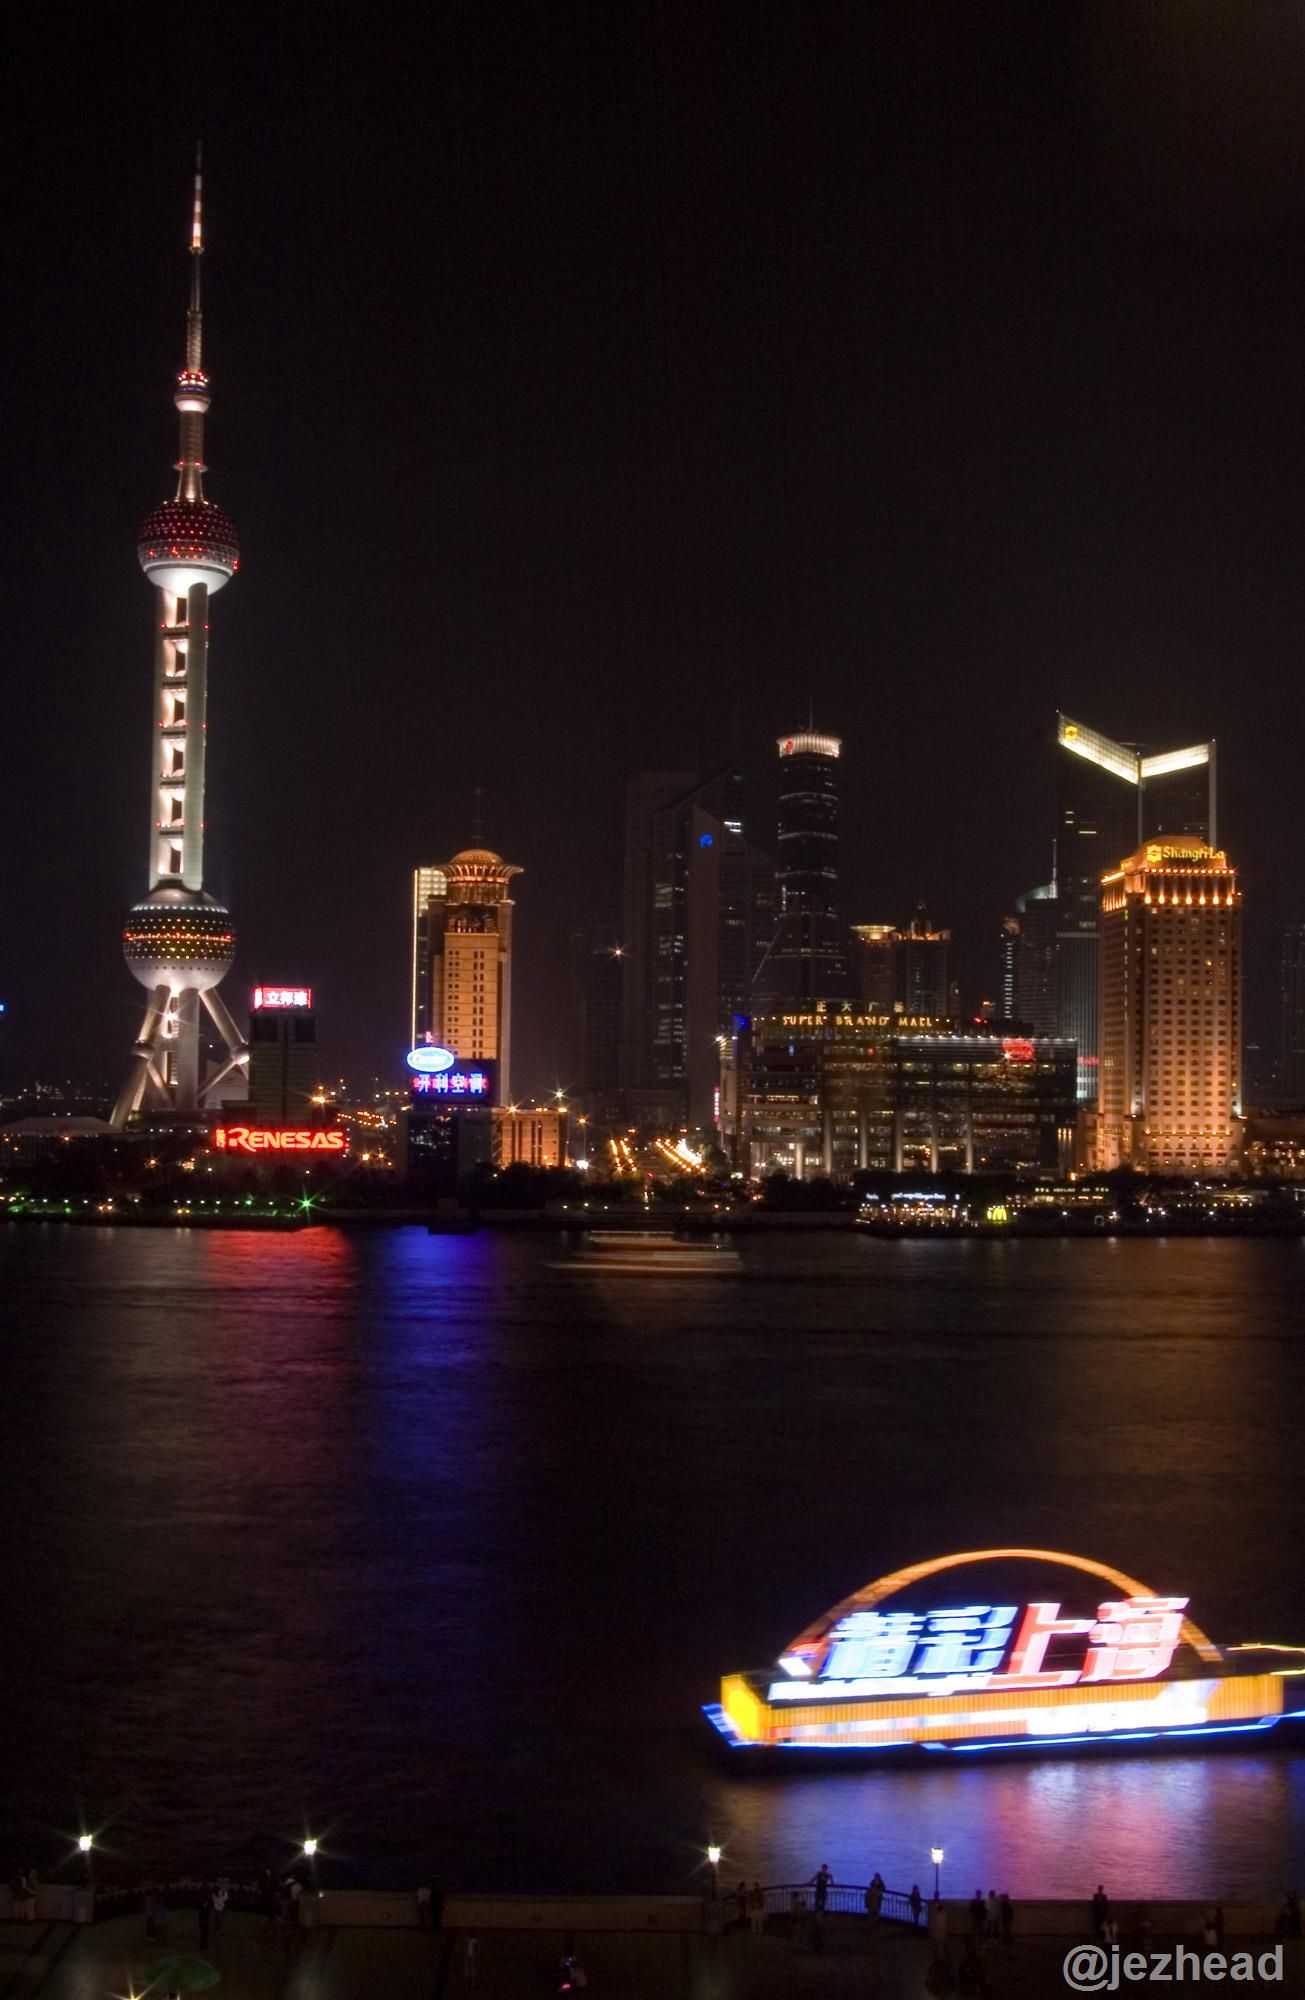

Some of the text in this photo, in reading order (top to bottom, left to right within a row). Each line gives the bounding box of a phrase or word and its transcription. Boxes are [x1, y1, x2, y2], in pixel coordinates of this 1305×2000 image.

[783, 1015, 824, 1026] SUPER
[836, 1015, 888, 1026] BRAND
[228, 1127, 344, 1152] RENESAS
